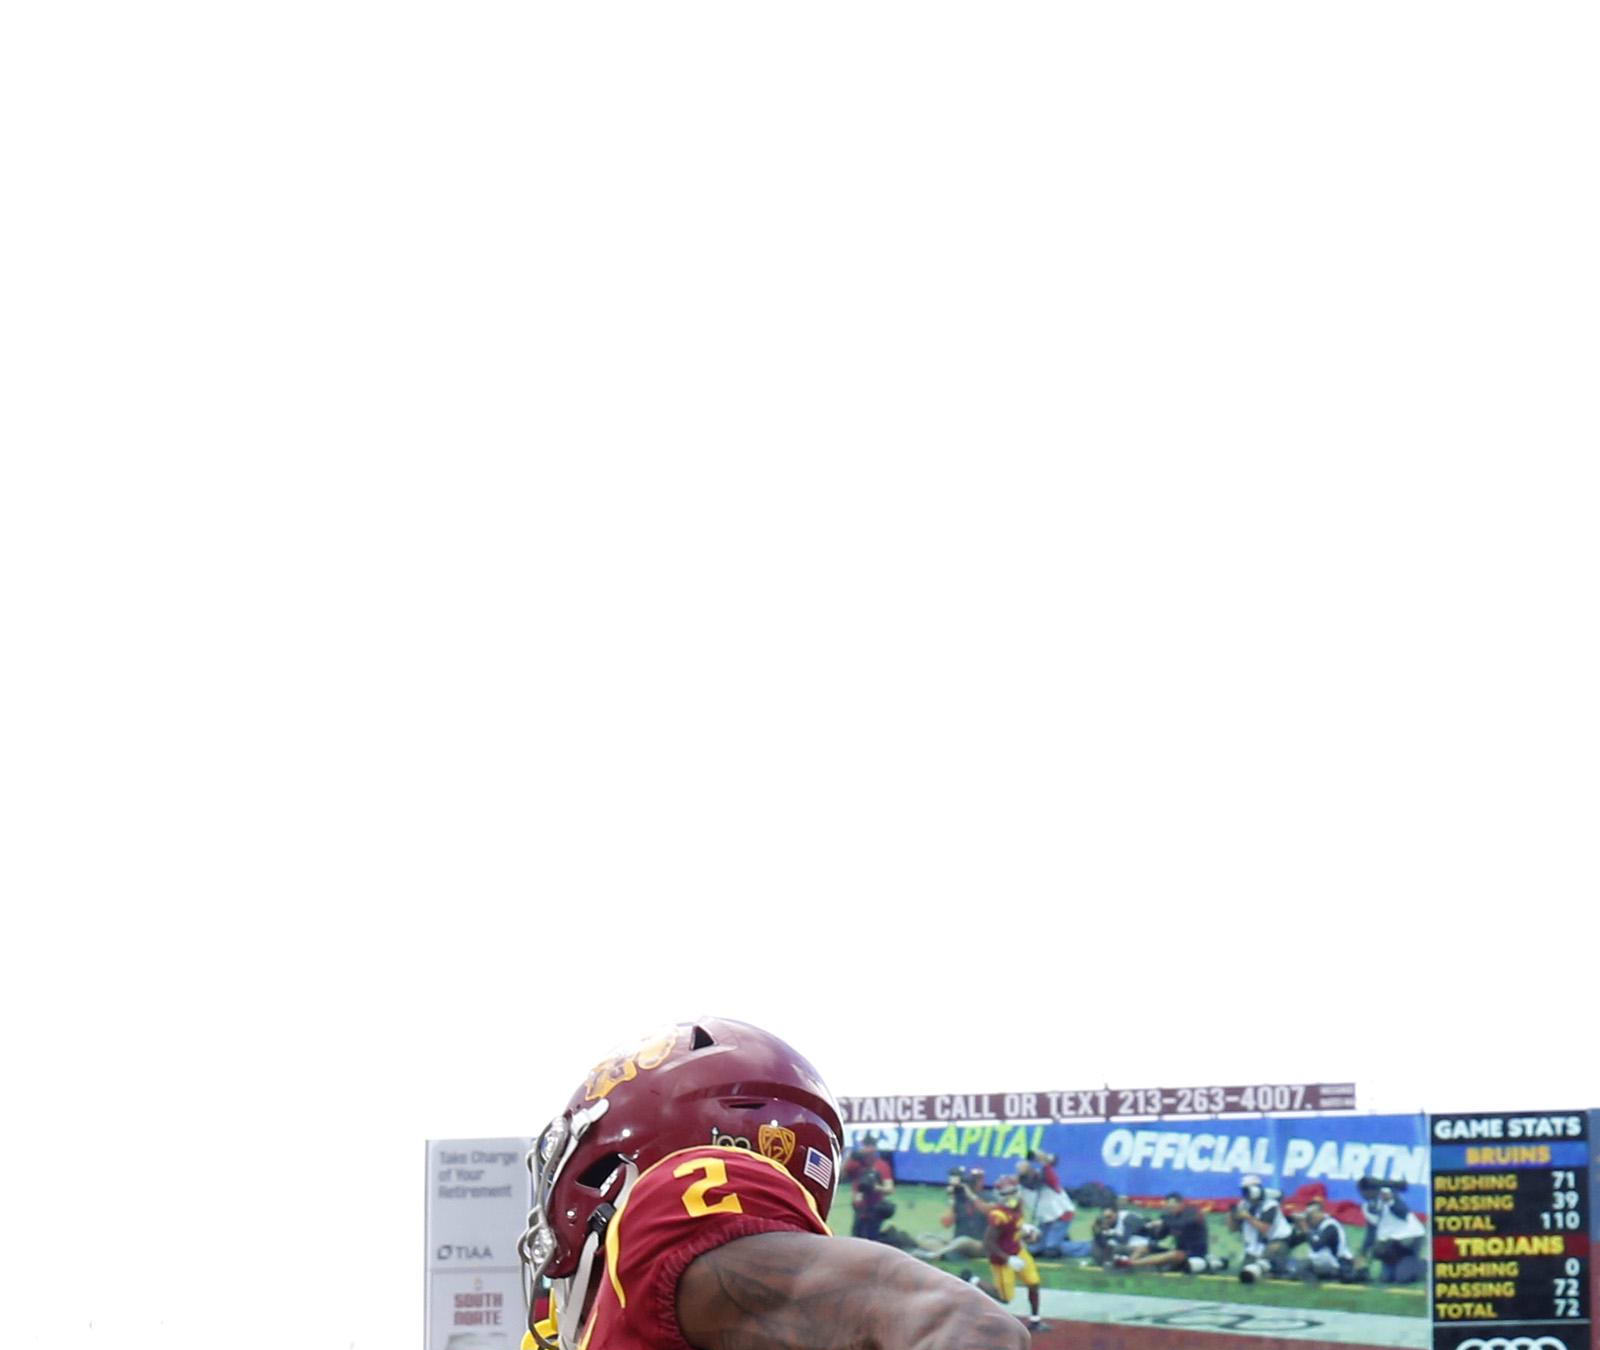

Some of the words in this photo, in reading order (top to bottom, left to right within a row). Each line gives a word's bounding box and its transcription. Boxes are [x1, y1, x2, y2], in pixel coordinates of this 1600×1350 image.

[838, 1096, 927, 1120] STANCE
[935, 1094, 996, 1118] CALL
[1004, 1093, 1037, 1117] OR
[1045, 1090, 1110, 1116] TEXT
[1118, 1086, 1313, 1114] 213-263-4007.
[1434, 1119, 1504, 1139] GAME
[1507, 1116, 1582, 1137] STATS
[1101, 1129, 1275, 1175] OFFICIAL
[1466, 1145, 1551, 1165] BRUINS
[455, 1168, 485, 1181] Your
[1434, 1174, 1518, 1191] RUSHING
[1552, 1171, 1576, 1189] 71
[438, 1185, 512, 1199] Retirement
[672, 1157, 743, 1218] 2
[1434, 1195, 1515, 1212] PASSING
[1552, 1191, 1579, 1210] 39
[1434, 1215, 1496, 1232] TOTAL
[1540, 1211, 1580, 1230] 110
[455, 1246, 494, 1259] TIAA
[1454, 1236, 1565, 1256] TROJANS
[1435, 1261, 1519, 1279] RUSHING
[1565, 1257, 1580, 1277] 0
[1435, 1281, 1516, 1299] PASSING
[1553, 1278, 1580, 1297] 72
[1436, 1302, 1497, 1319] TOTAL
[1554, 1299, 1580, 1317] 72
